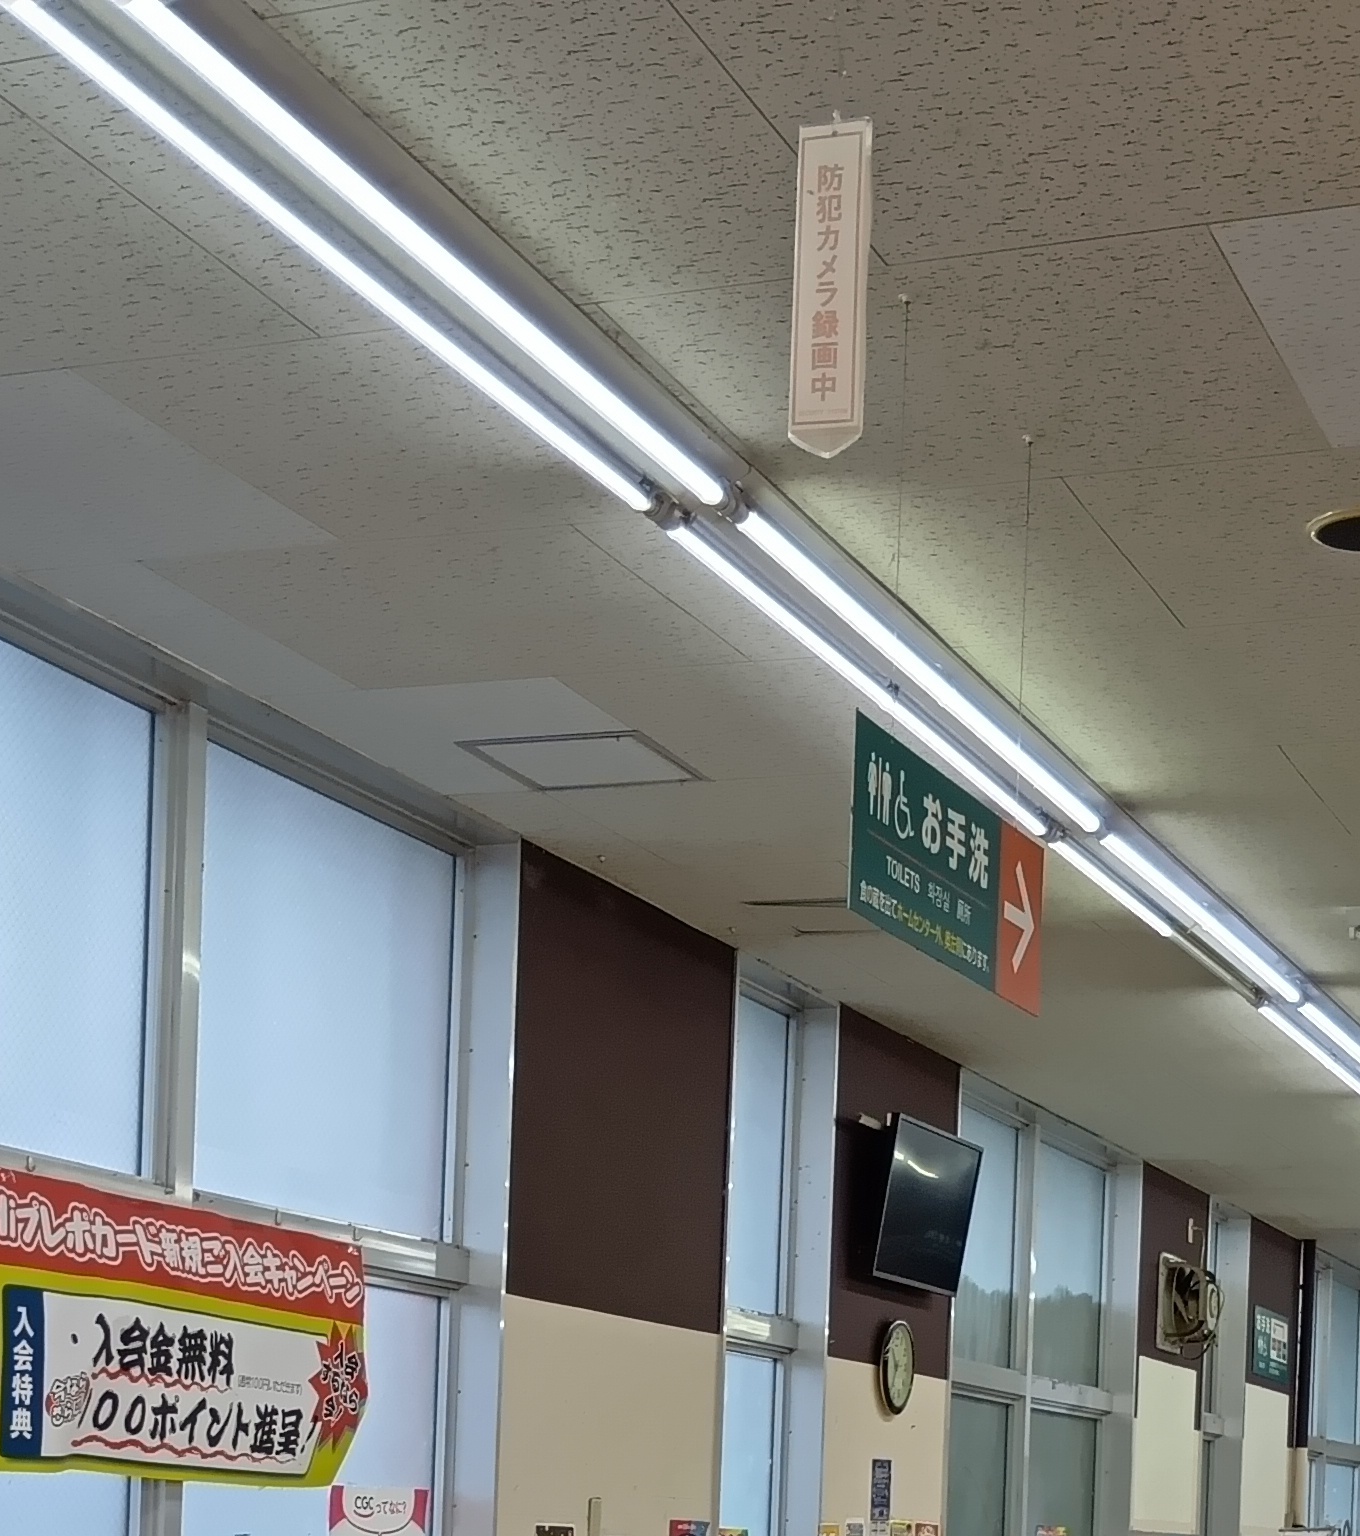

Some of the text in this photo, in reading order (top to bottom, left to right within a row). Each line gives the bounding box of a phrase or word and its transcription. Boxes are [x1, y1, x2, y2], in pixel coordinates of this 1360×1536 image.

[810, 164, 844, 402] 防犯カメラ録画中
[886, 855, 920, 894] TOILETS
[921, 794, 989, 889] お手洗
[10, 1305, 35, 1440] 入会特典
